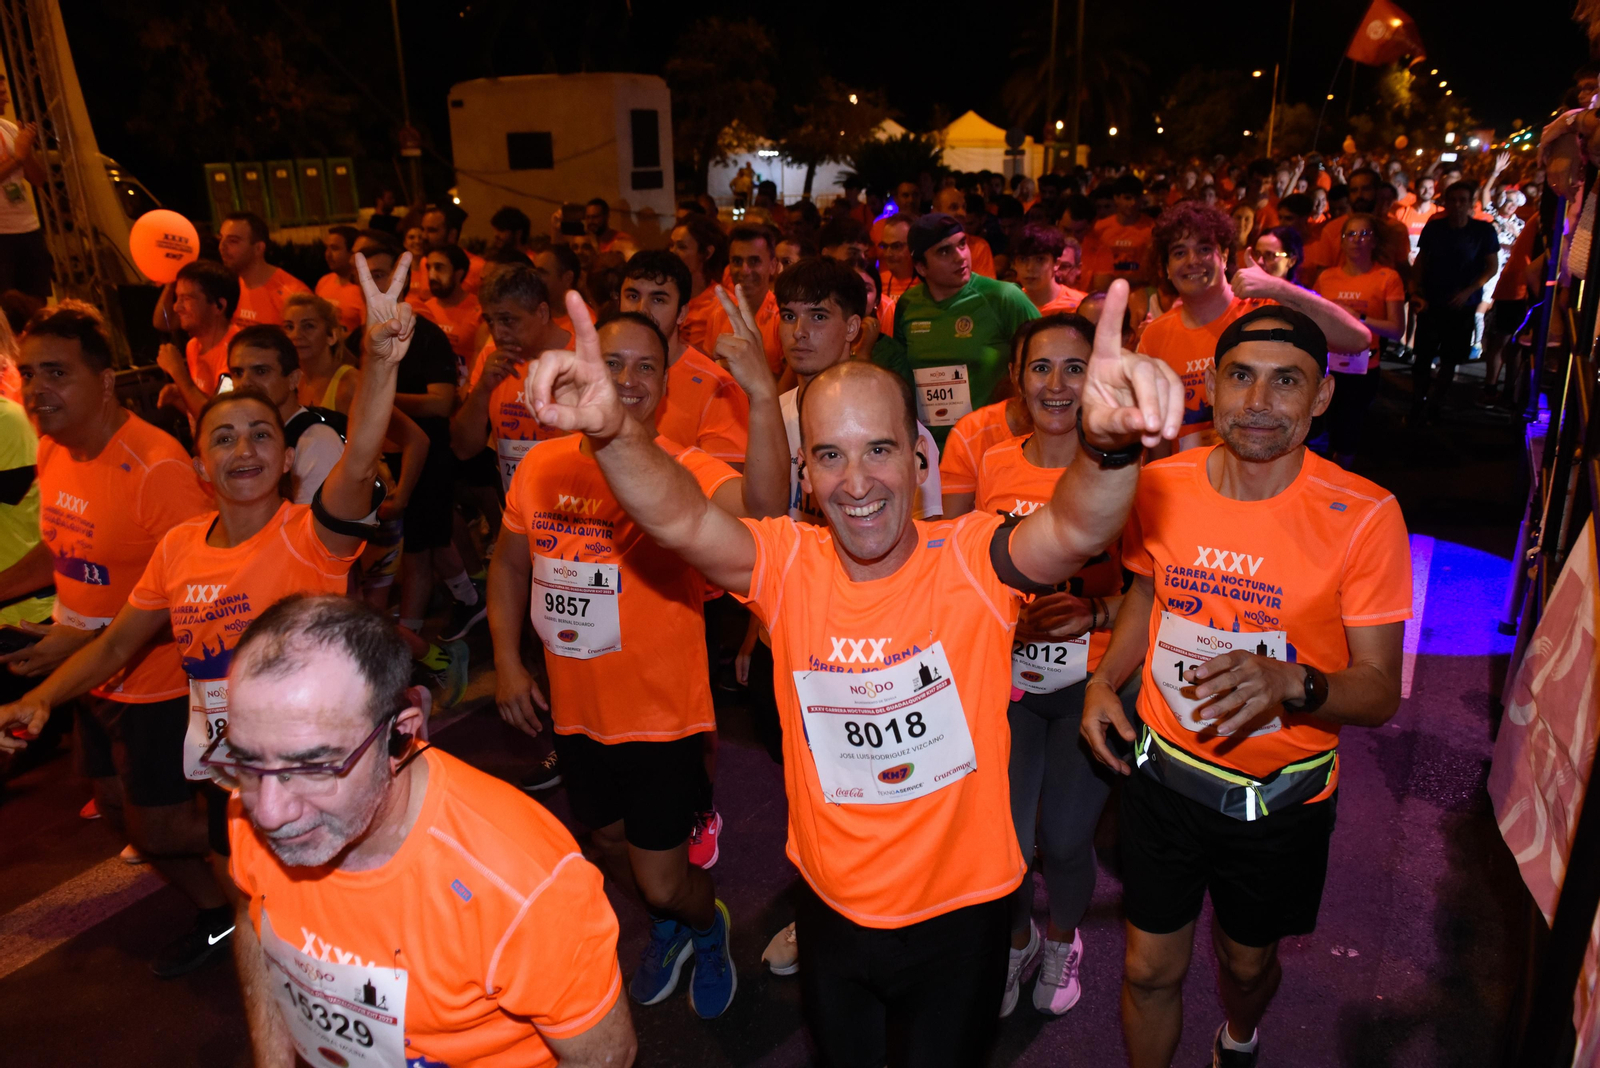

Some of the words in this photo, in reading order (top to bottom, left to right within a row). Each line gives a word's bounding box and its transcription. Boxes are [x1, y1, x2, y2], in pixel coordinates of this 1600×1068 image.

[1338, 291, 1362, 299] XXXV
[926, 388, 954, 402] 5401
[56, 490, 89, 515] XXXV
[554, 494, 603, 515] XXXV
[533, 511, 569, 522] CARRERA
[573, 516, 615, 528] NOCTURNA
[536, 520, 613, 540] GUADALQUIVIR
[1193, 545, 1264, 577] XXXV
[1165, 564, 1216, 582] CARRERA
[1221, 574, 1284, 597] NOCTURNA
[544, 592, 591, 618] 9857
[1170, 577, 1282, 610] GUADALQUIVIR
[558, 618, 573, 627] BERNAL
[573, 620, 595, 628] EDUARDO
[1013, 640, 1068, 665] 2012
[1019, 660, 1032, 668] ROSA
[850, 681, 894, 698] NO8DO
[886, 693, 926, 711] GUADALQUIVIR
[926, 687, 937, 696] KH7
[936, 680, 948, 690] 2023
[844, 711, 927, 749] 8018
[870, 748, 911, 761] RODRIGUEZ
[911, 733, 945, 753] VIZCAINO
[934, 761, 971, 783] Cruzcampo
[284, 981, 375, 1049] 15329
[378, 1013, 394, 1024] 2023
